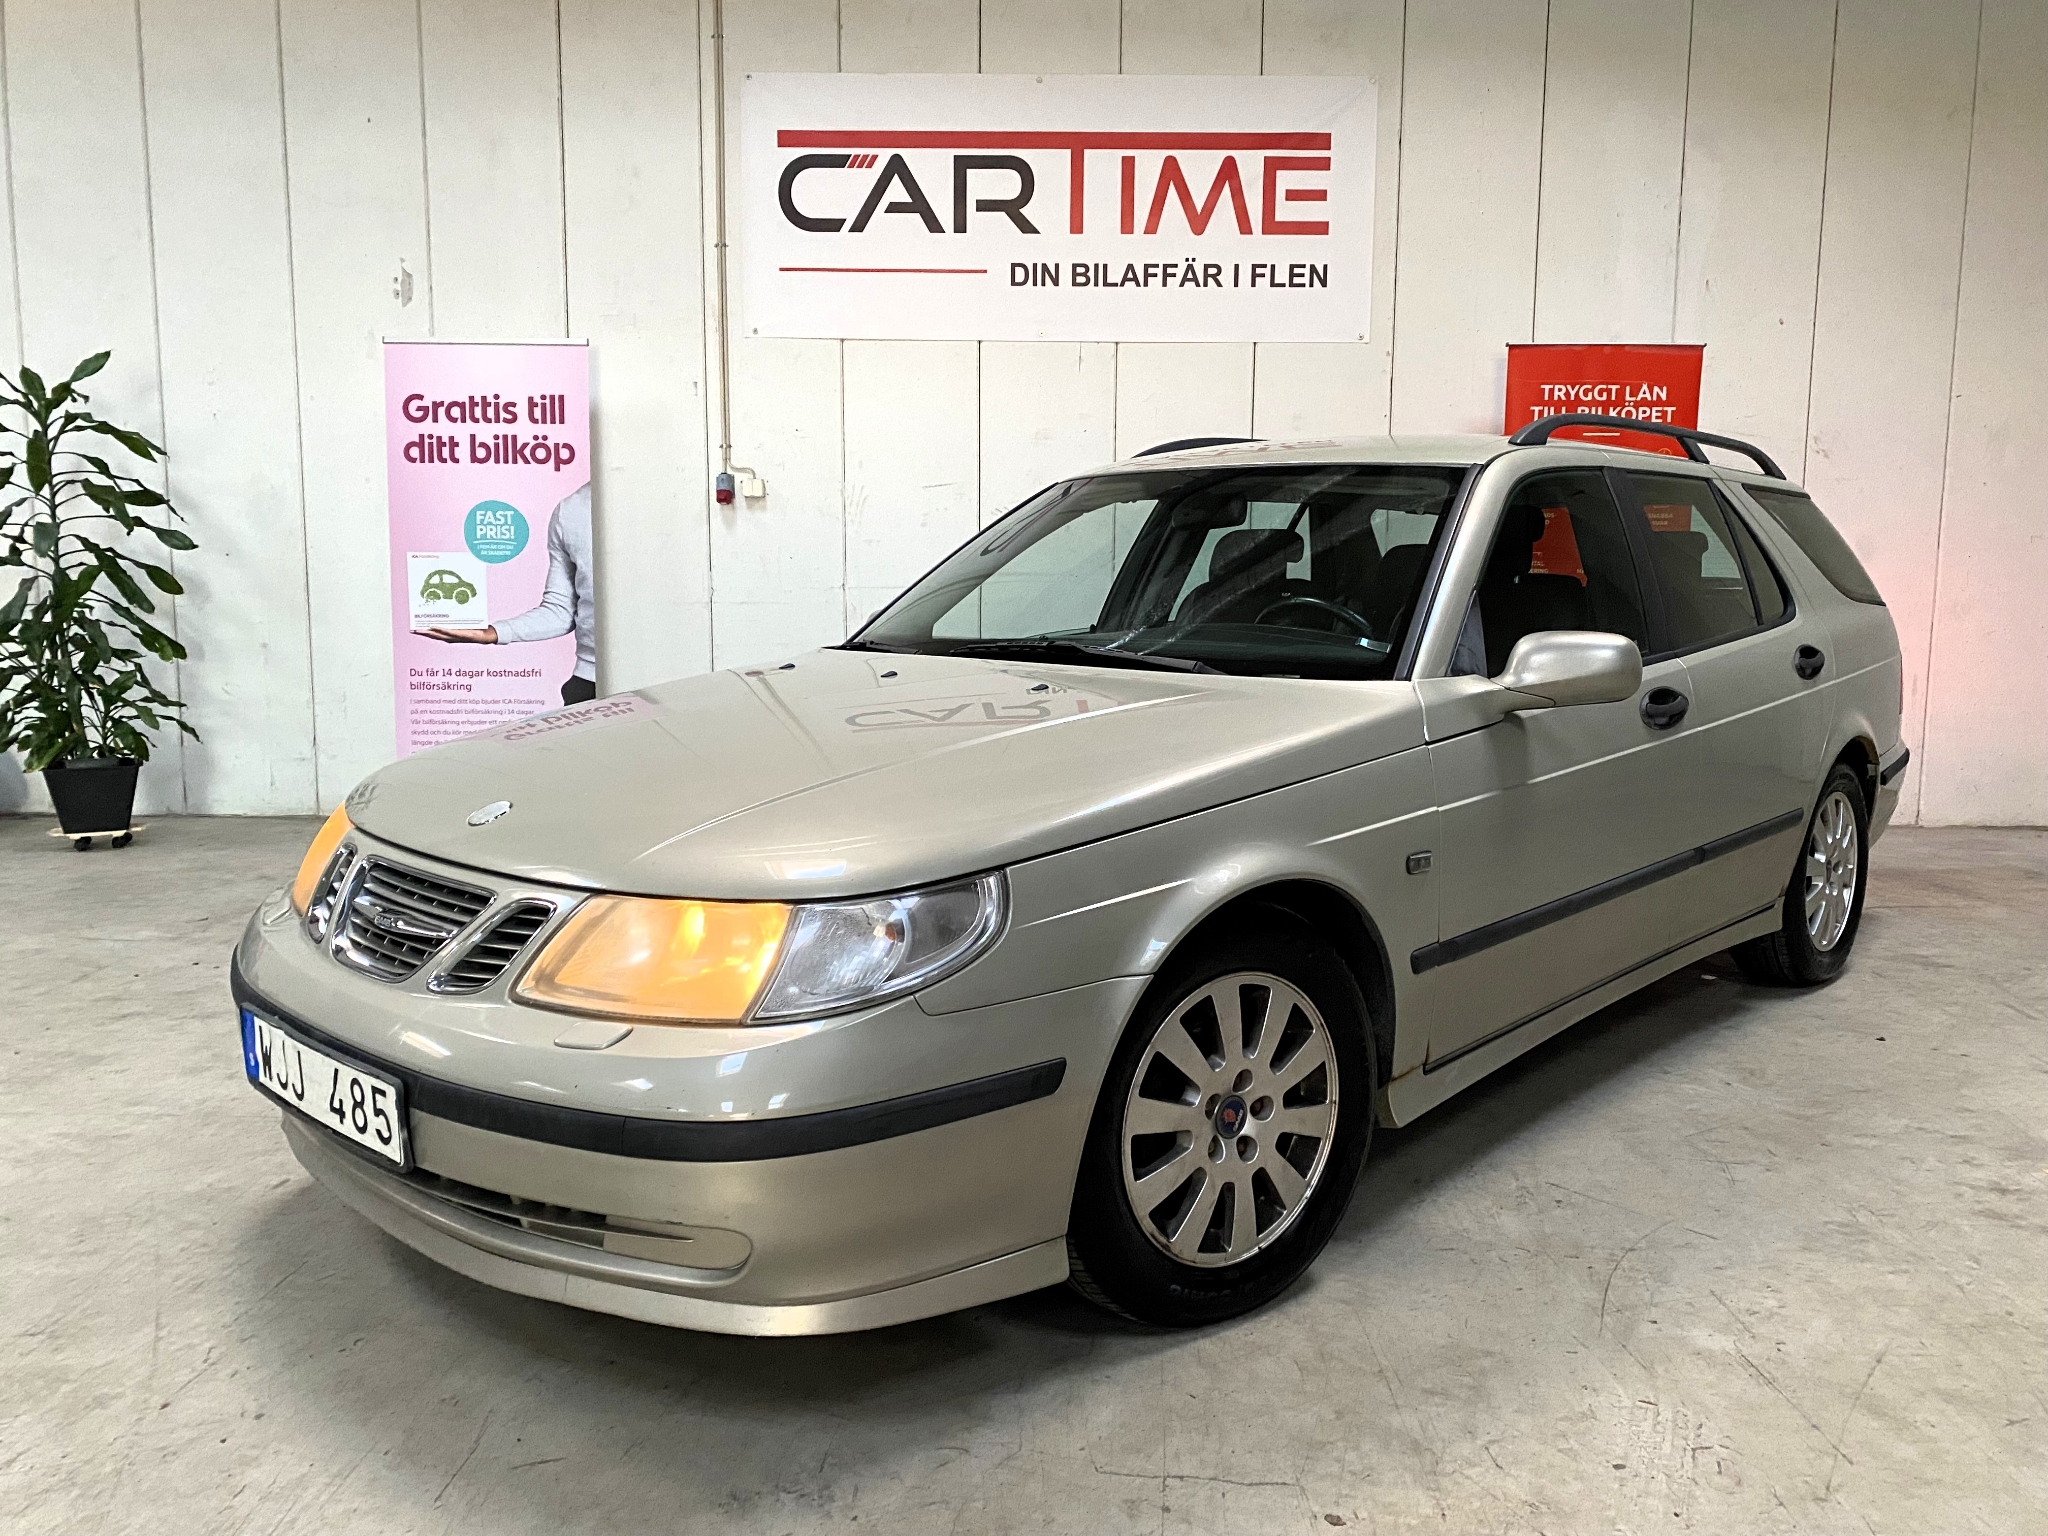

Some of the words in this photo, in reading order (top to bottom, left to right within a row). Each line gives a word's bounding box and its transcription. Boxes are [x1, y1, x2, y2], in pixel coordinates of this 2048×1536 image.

[777, 130, 1332, 235] CARTIME
[1010, 262, 1059, 287] DIN
[1071, 257, 1223, 288] BILAFFÄR
[1233, 263, 1240, 288] I
[1250, 263, 1328, 288] FLEN
[1541, 384, 1620, 401] TRYGGT
[1625, 382, 1667, 401] LÅN
[402, 393, 518, 424] Grattis
[527, 394, 565, 425] till
[403, 433, 460, 464] ditt
[469, 433, 576, 472] bilköp
[476, 510, 514, 525] FAST
[476, 525, 515, 539] PRIS!
[409, 668, 423, 677] Du
[426, 667, 439, 677] får
[442, 668, 452, 677] 14
[455, 668, 484, 679] dagar
[486, 668, 542, 678] kostnadsfri
[410, 681, 472, 693] bilförsäkring
[422, 719, 460, 727] bilförsäkring
[461, 719, 488, 727] erbjuder
[259, 1025, 305, 1102] WJJ
[329, 1068, 392, 1146] 485
